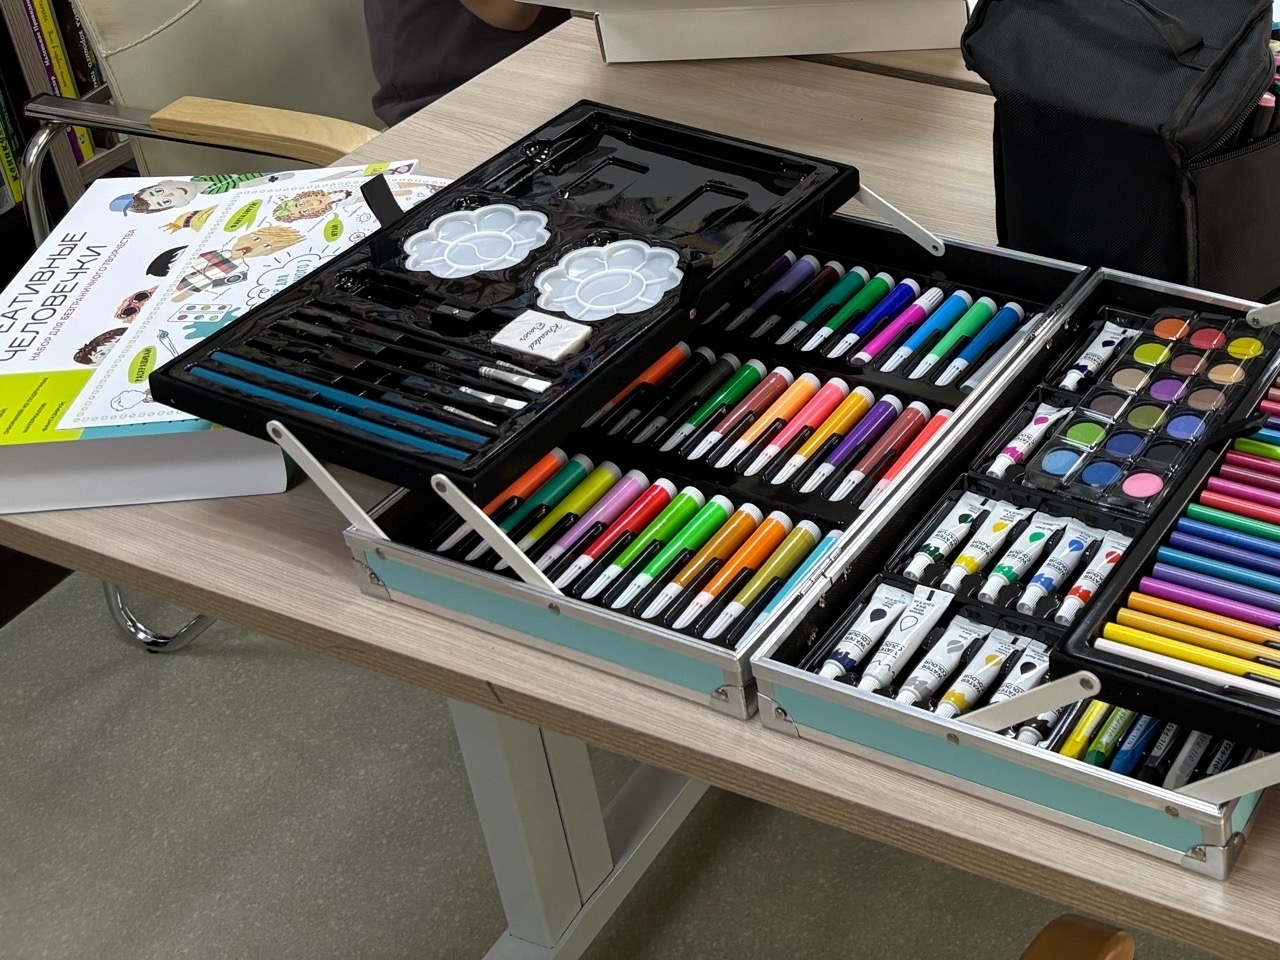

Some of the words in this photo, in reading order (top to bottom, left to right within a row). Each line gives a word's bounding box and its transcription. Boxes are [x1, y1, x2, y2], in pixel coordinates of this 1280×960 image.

[0, 231, 88, 334] ЕАТИВНЫЕ
[0, 245, 108, 362] ЧЕЛОВЕЧКИ
[29, 336, 52, 361] НАБОР
[50, 321, 66, 337] ДЛЯ
[61, 266, 107, 321] БЕЗГРАНИЧНОГО
[102, 228, 137, 267] ТВОРЧЕСТВА
